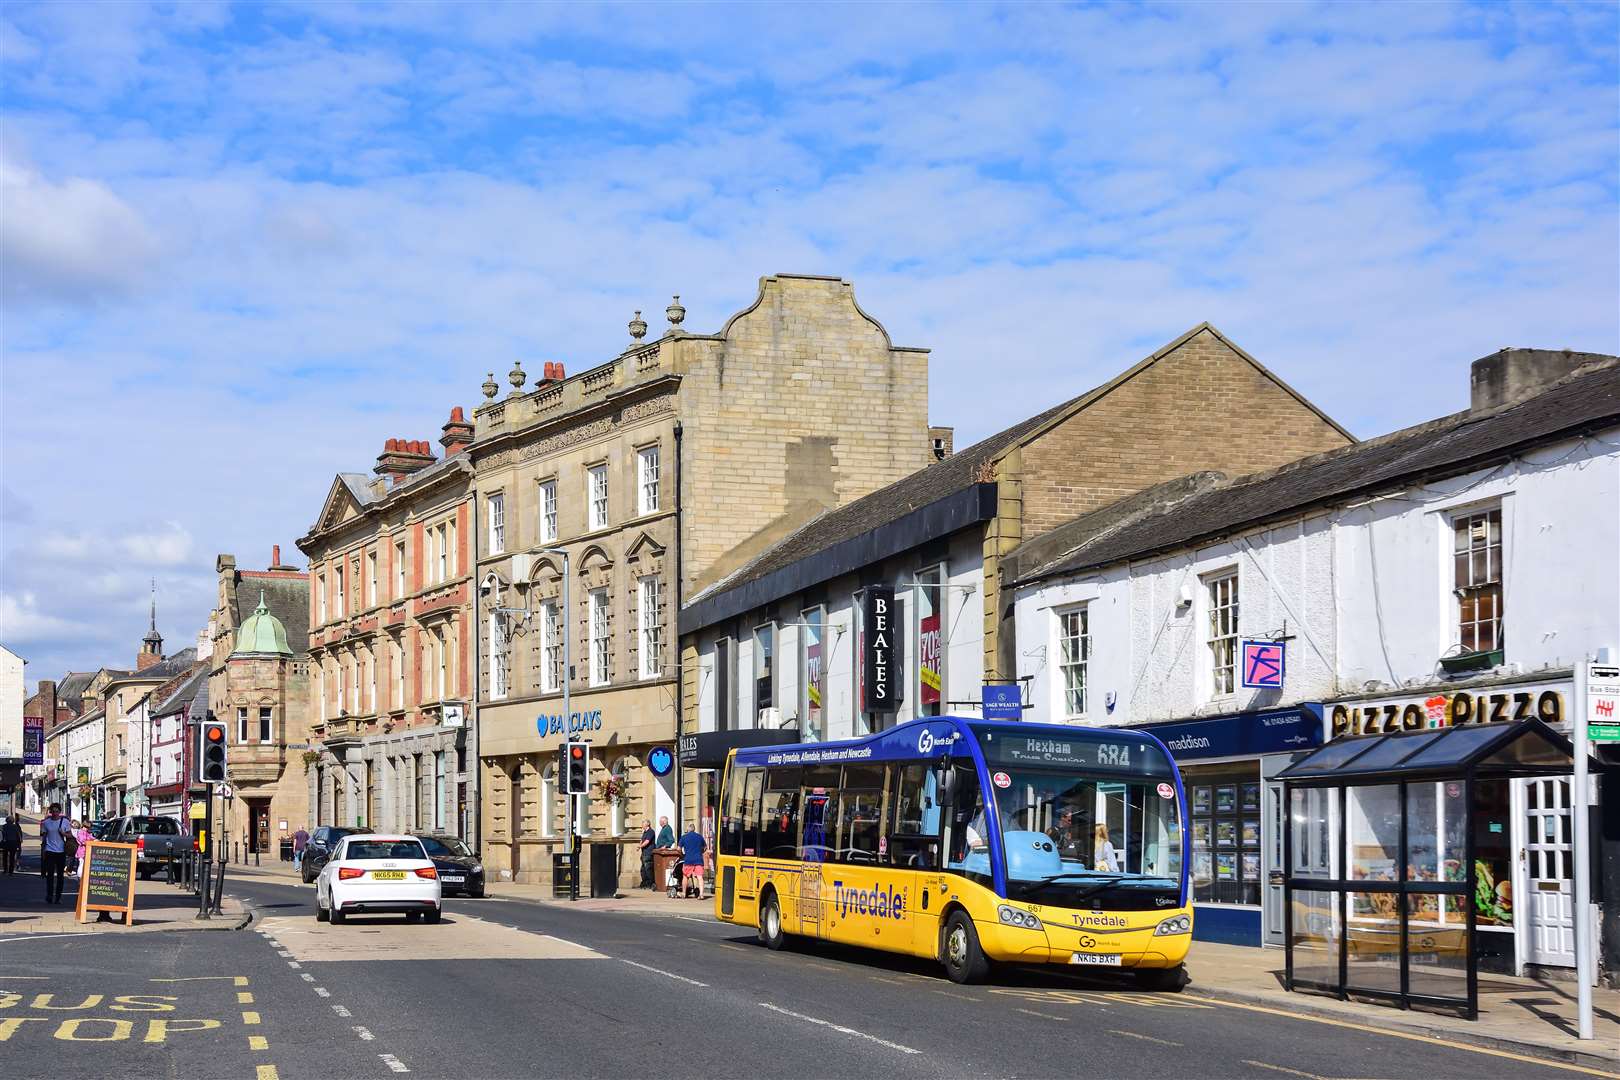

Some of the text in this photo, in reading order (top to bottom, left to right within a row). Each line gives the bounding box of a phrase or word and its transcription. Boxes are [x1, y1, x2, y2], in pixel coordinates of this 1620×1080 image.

[872, 597, 889, 699] BEALES
[26, 718, 42, 727] SALE
[1027, 738, 1071, 754] Hexham
[1168, 733, 1210, 750] maddison
[767, 753, 781, 764] Linking
[821, 750, 838, 760] Hexham
[838, 749, 848, 759] and
[848, 747, 872, 758] Newcastle
[1097, 743, 1130, 766] 684
[833, 880, 902, 920] Tynedale
[1071, 914, 1125, 927] Tynedale
[1099, 955, 1116, 963] BXH
